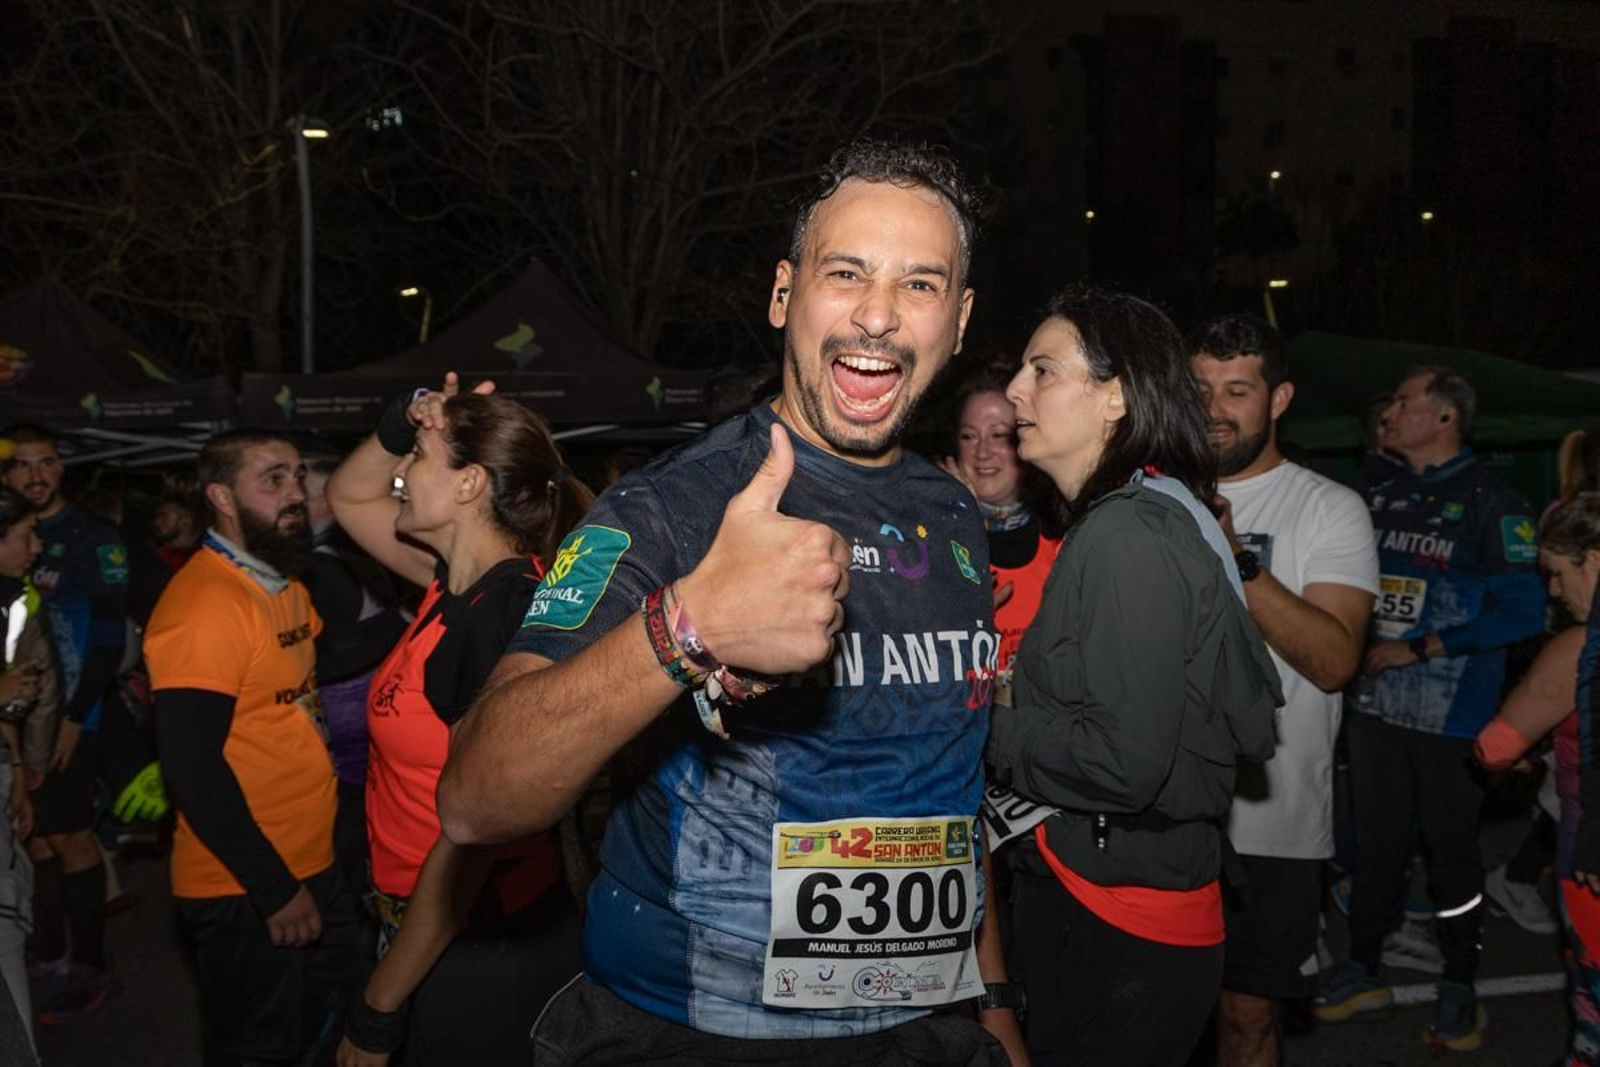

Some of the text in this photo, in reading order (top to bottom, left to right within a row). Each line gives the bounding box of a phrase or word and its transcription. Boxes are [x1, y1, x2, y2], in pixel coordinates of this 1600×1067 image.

[1382, 594, 1415, 616] 55
[875, 827, 914, 836] CARRERA
[831, 828, 874, 859] 42
[874, 843, 901, 857] SAN
[796, 868, 967, 935] 6300
[808, 937, 957, 953] MANUEL JESÚS DELGADO MORENO
